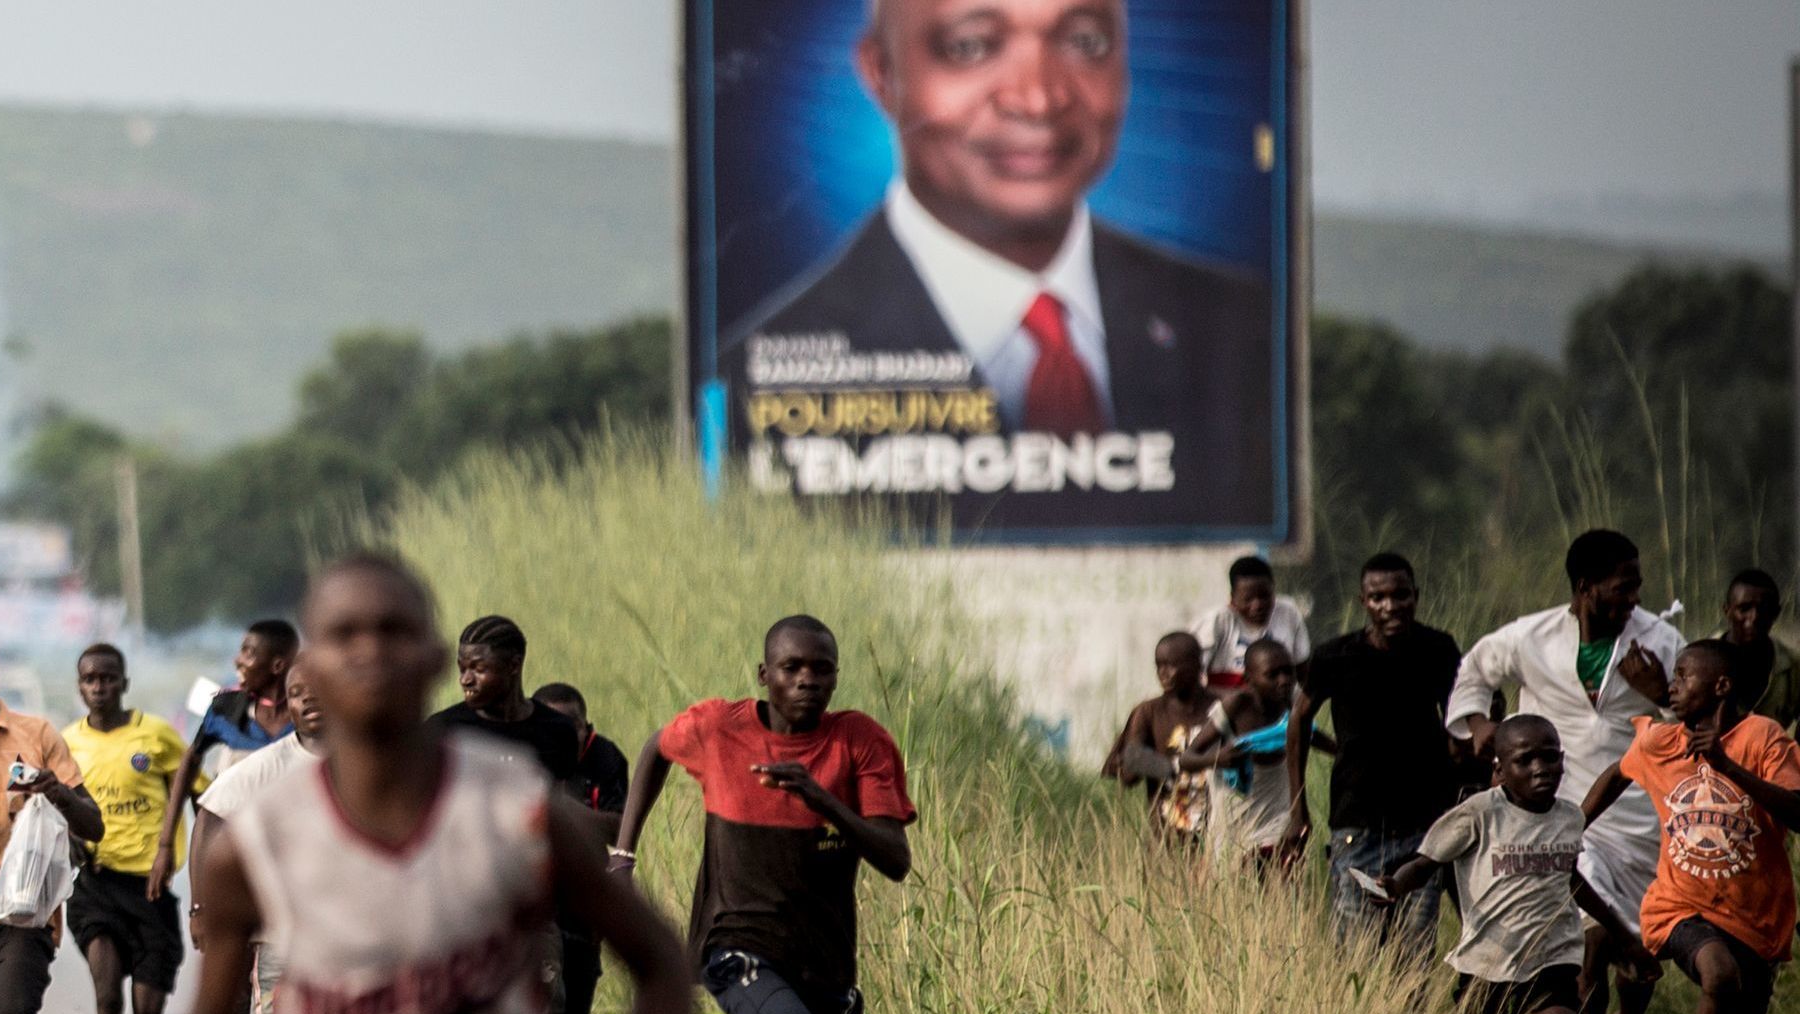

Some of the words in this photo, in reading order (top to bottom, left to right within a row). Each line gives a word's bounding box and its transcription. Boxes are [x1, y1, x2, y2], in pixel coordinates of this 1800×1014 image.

[750, 391, 997, 436] POURSUIVRE
[748, 432, 1175, 494] L'EMERGENCE
[1501, 844, 1534, 853] JOHN
